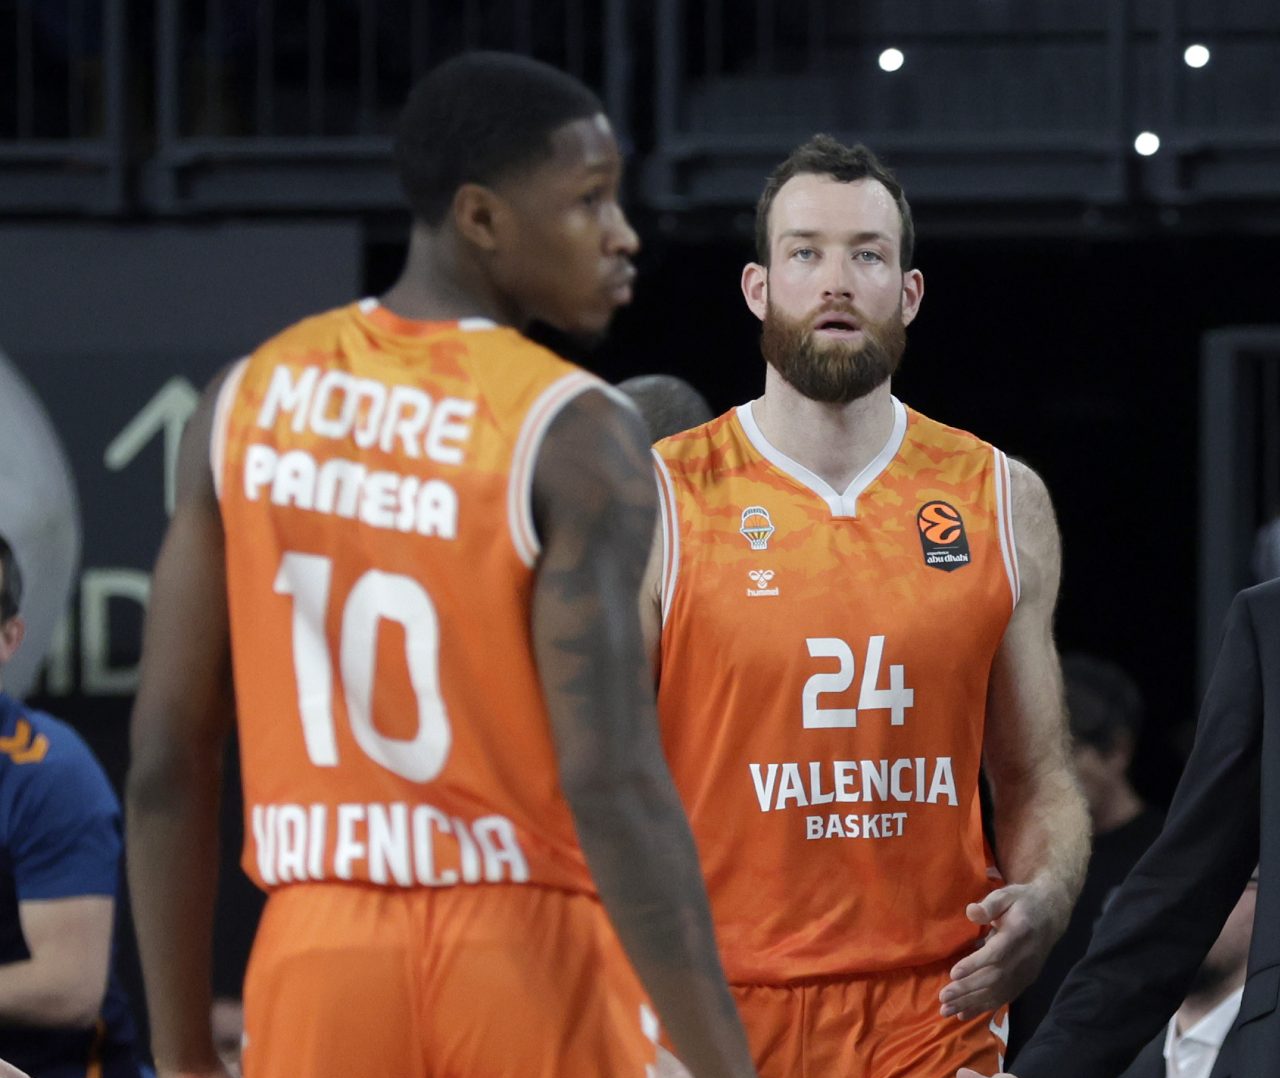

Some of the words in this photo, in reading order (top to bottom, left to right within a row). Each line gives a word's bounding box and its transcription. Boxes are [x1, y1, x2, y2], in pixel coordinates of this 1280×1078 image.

[257, 365, 477, 464] MOORE
[244, 444, 458, 540] PAMESA
[746, 586, 780, 598] hummel
[926, 554, 944, 563] abu
[944, 553, 969, 563] dhabi
[273, 551, 453, 784] 10
[802, 635, 914, 729] 24
[748, 757, 959, 813] VALENCIA
[805, 812, 908, 841] BASKET
[252, 801, 531, 888] VALENCIA
